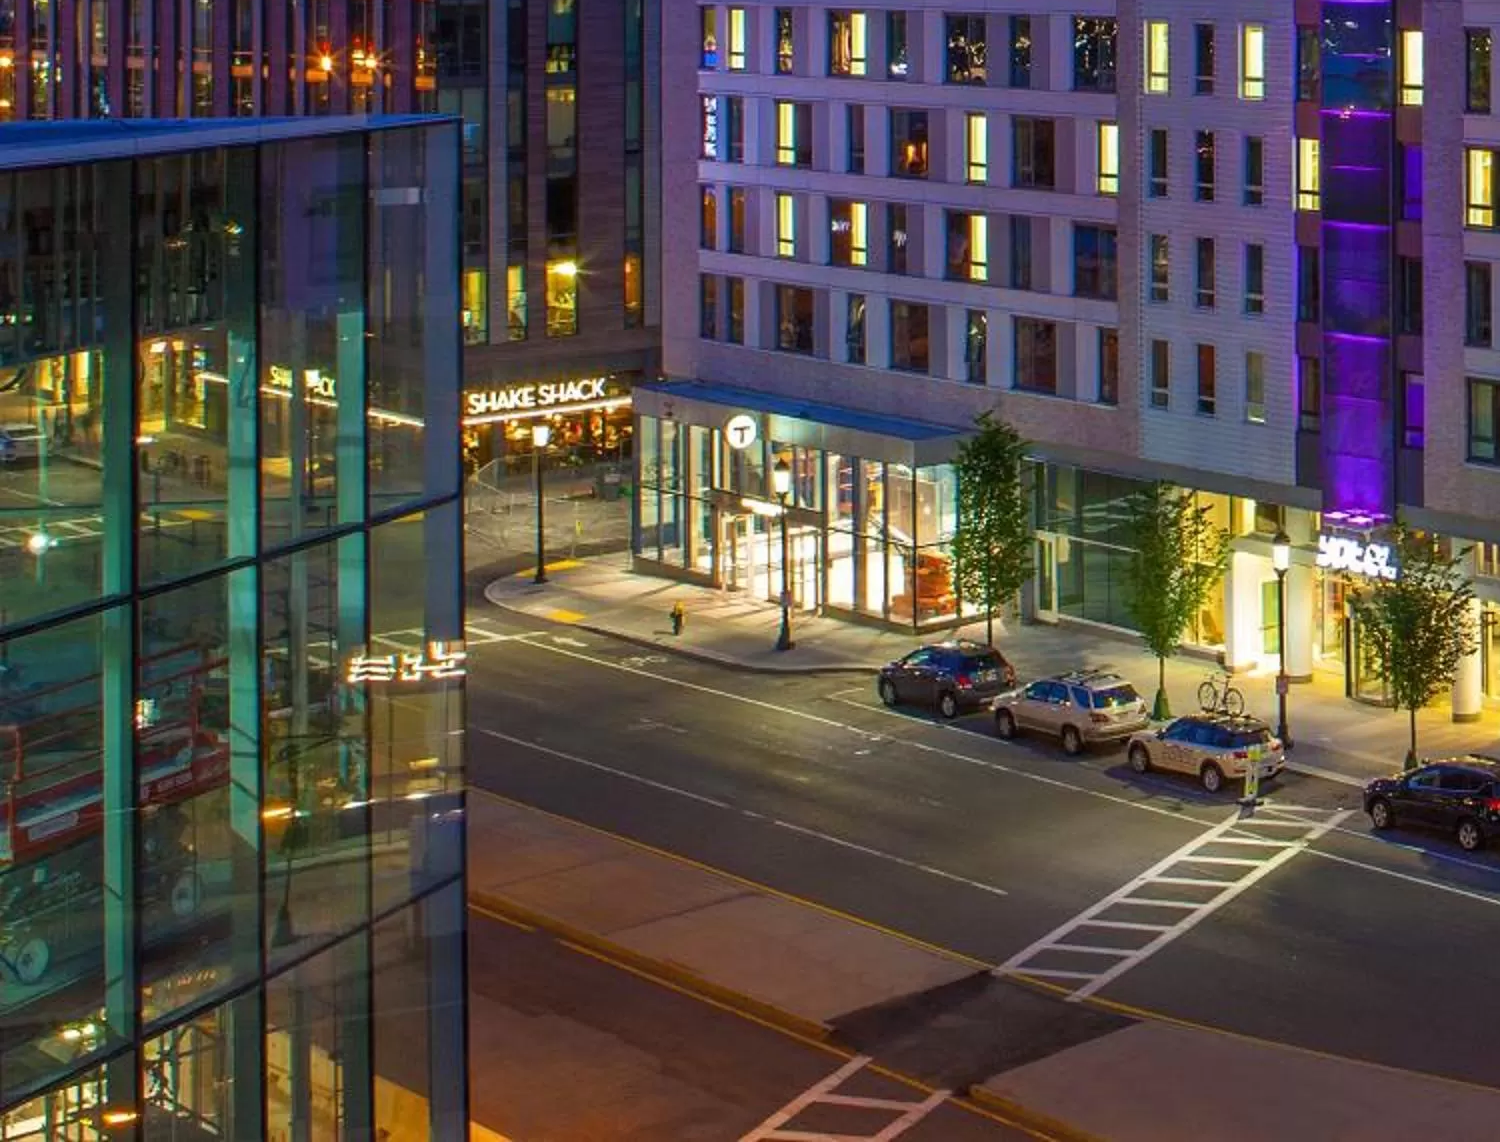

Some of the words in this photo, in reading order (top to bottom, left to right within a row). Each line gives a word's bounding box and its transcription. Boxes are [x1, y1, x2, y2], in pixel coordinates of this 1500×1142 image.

[468, 387, 536, 414] SHAKE
[538, 378, 605, 405] SHACK
[733, 426, 750, 444] T
